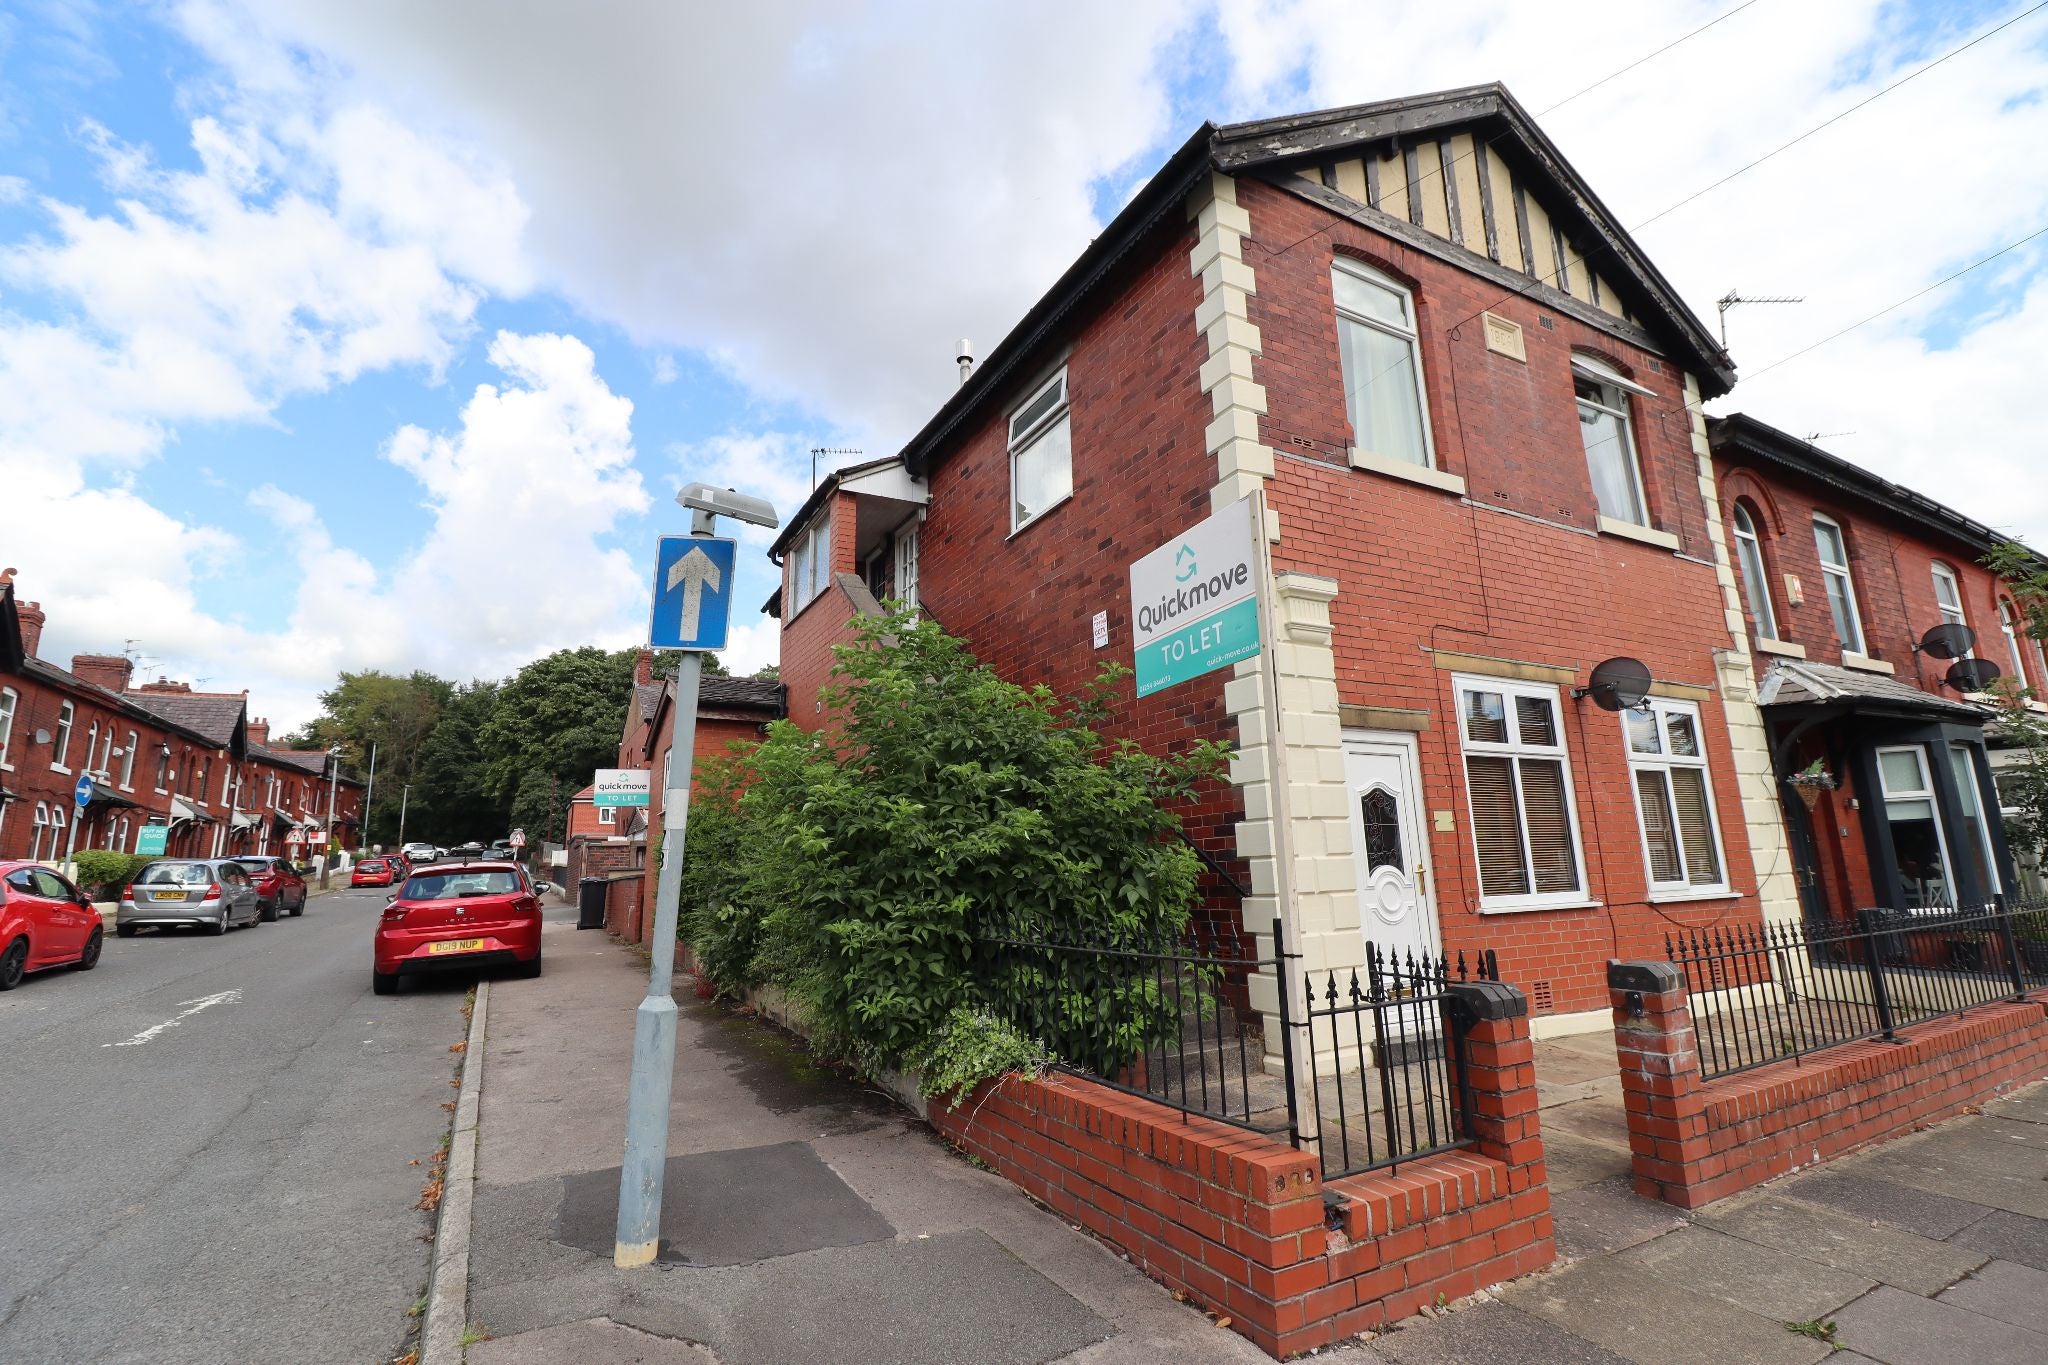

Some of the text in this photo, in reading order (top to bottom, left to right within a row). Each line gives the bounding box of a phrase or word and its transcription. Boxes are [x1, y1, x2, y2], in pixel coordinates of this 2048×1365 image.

[1138, 562, 1248, 633] Quickmove
[1161, 621, 1223, 666] TO LET
[436, 940, 478, 951] DG19 NUP
